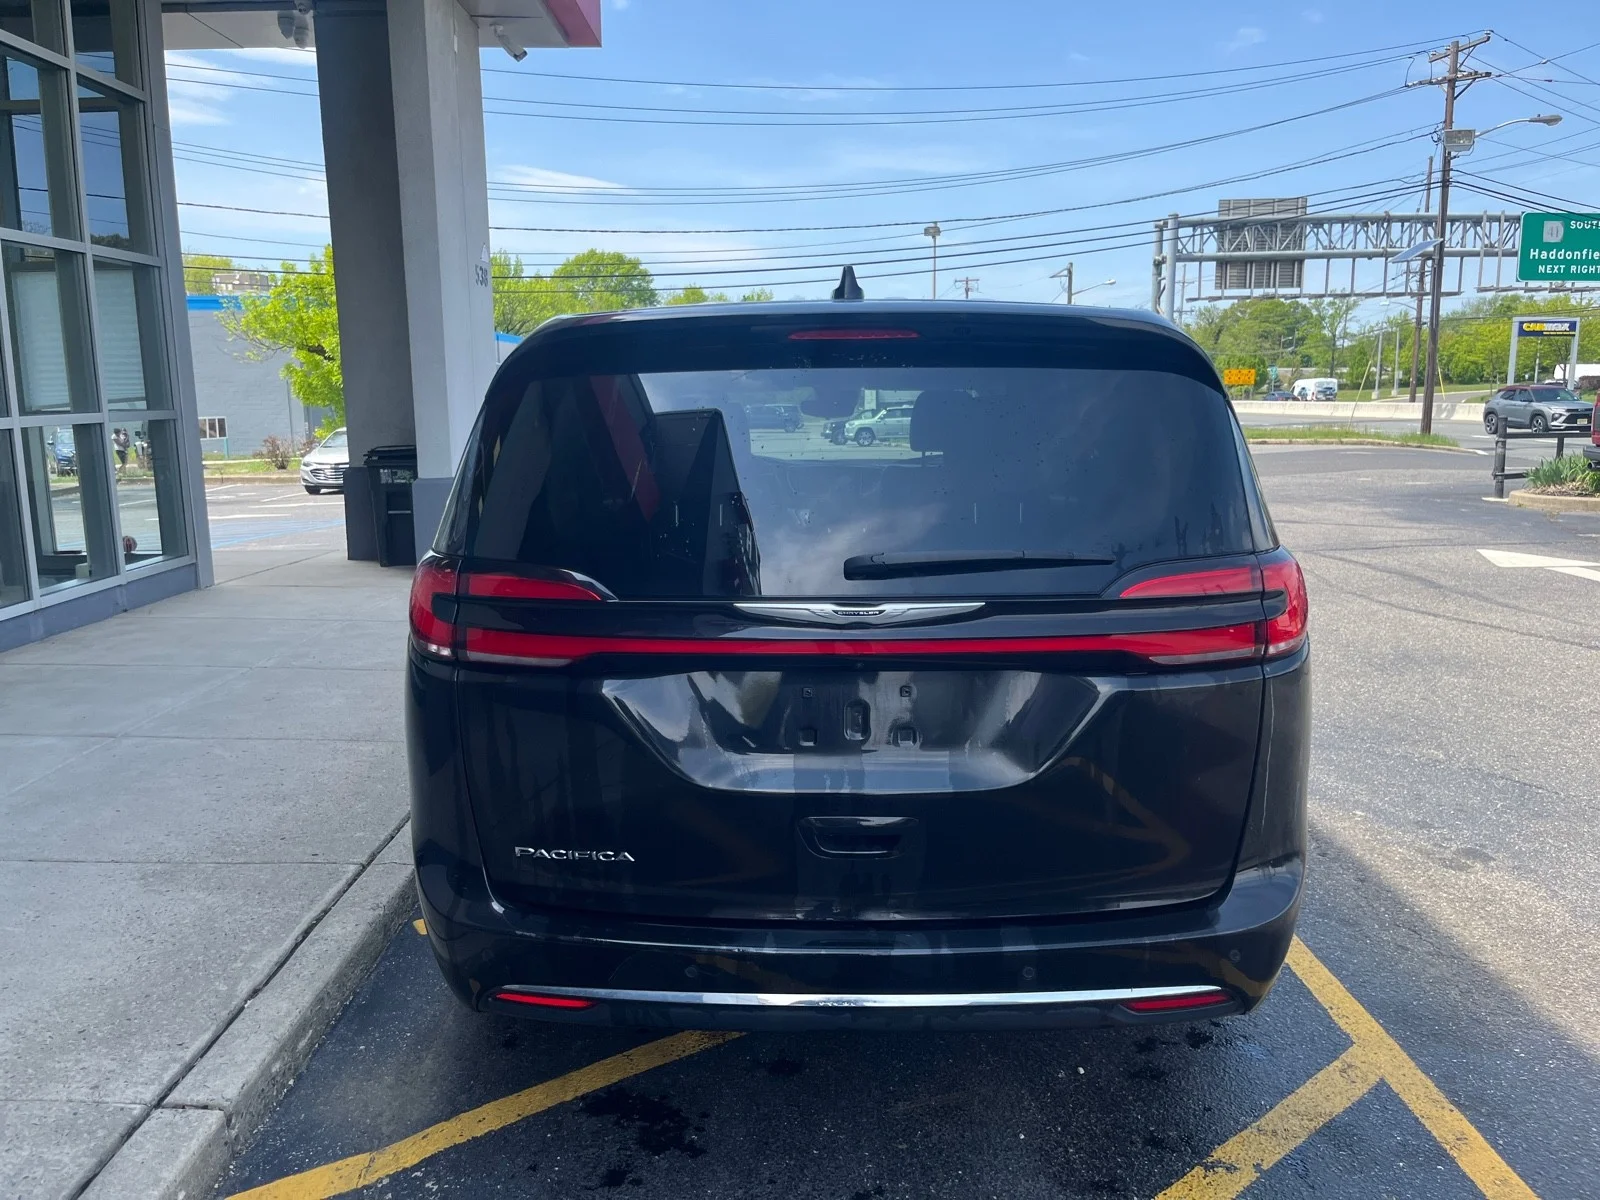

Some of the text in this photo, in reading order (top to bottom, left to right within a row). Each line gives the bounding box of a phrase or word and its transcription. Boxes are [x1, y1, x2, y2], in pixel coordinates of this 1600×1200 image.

[1530, 248, 1600, 260] Haddonfie
[1538, 265, 1600, 274] NEXT RIGHT
[514, 846, 635, 861] PACIFICA
